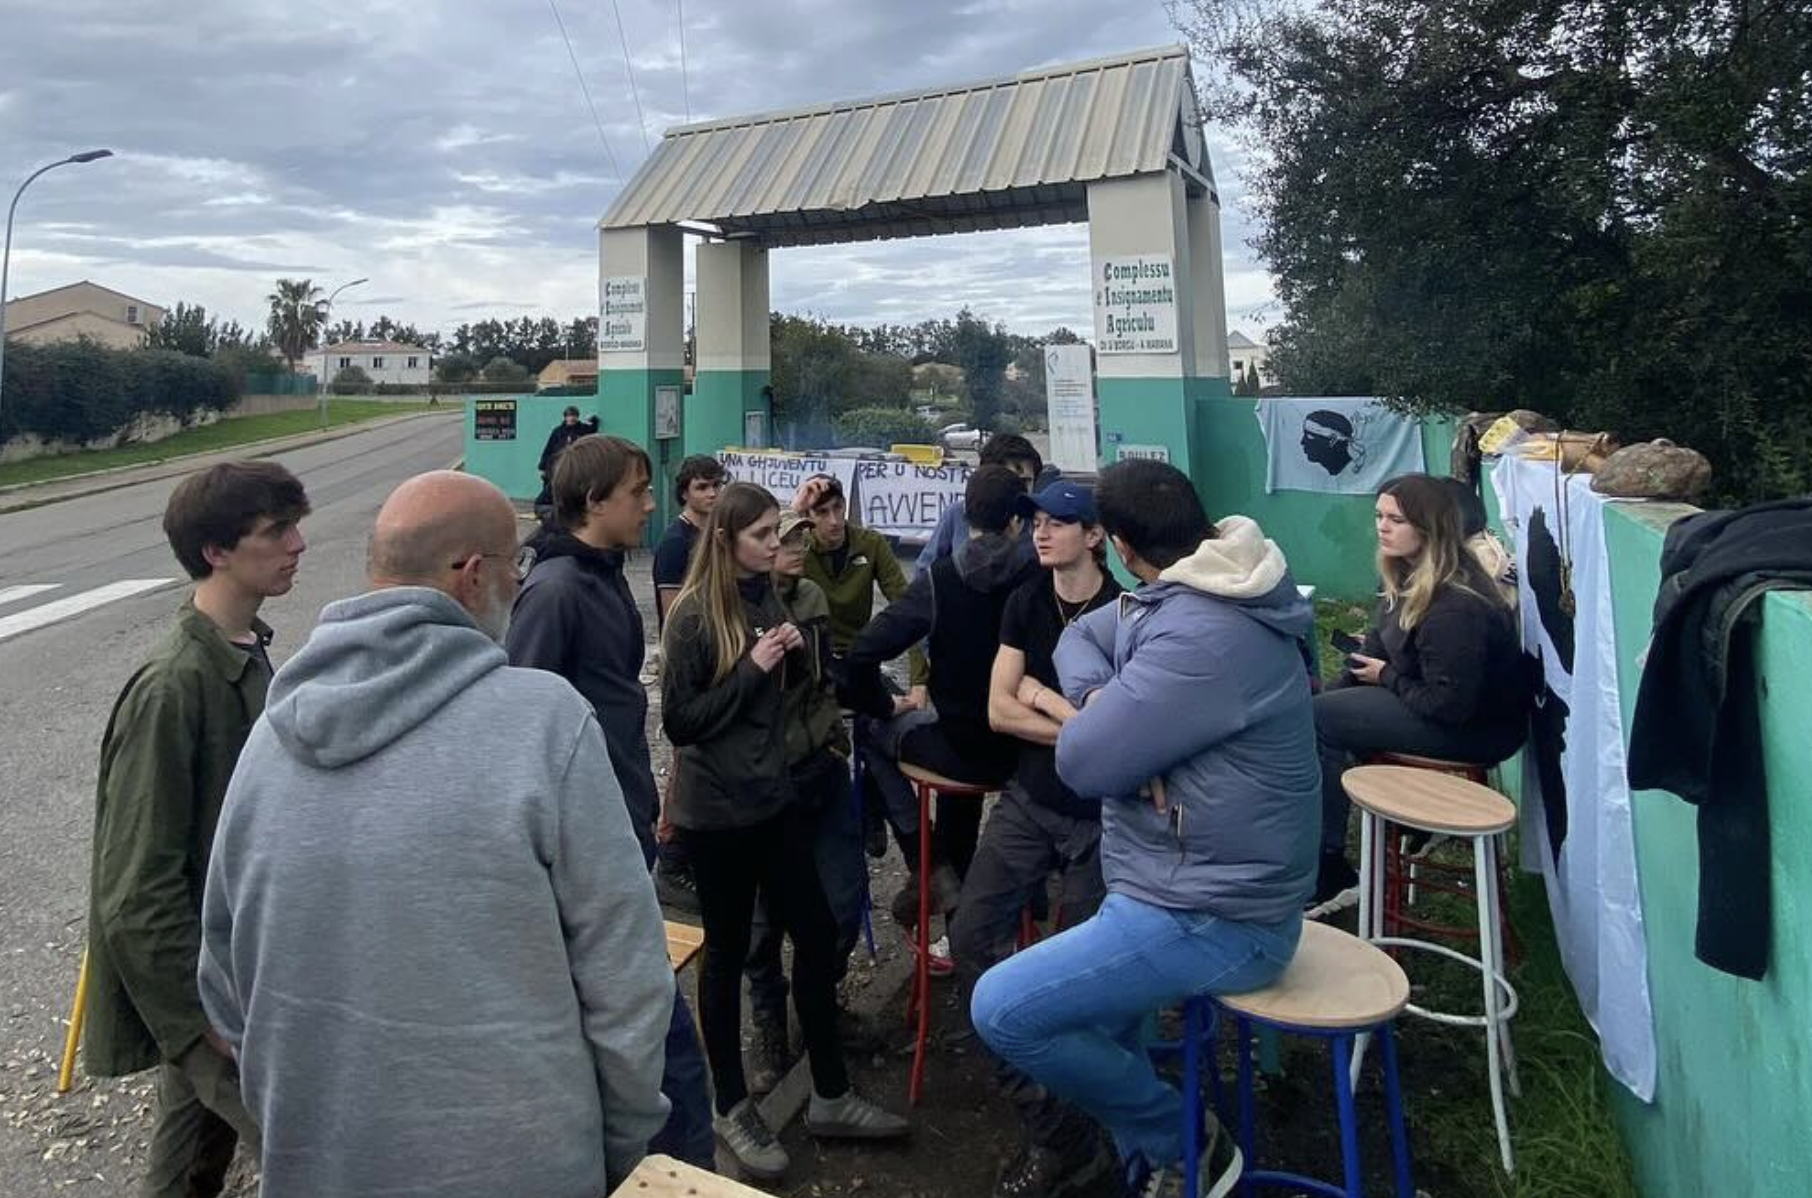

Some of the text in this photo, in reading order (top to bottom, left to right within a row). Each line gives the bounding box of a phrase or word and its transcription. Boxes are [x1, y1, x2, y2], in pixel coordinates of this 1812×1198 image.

[1104, 258, 1169, 284] Complessu
[1105, 285, 1173, 310] Insignamentu
[1106, 311, 1155, 338] Agriculu
[719, 453, 827, 472] UNA GHJUVENTU
[858, 462, 887, 480] PER
[895, 464, 906, 476] U
